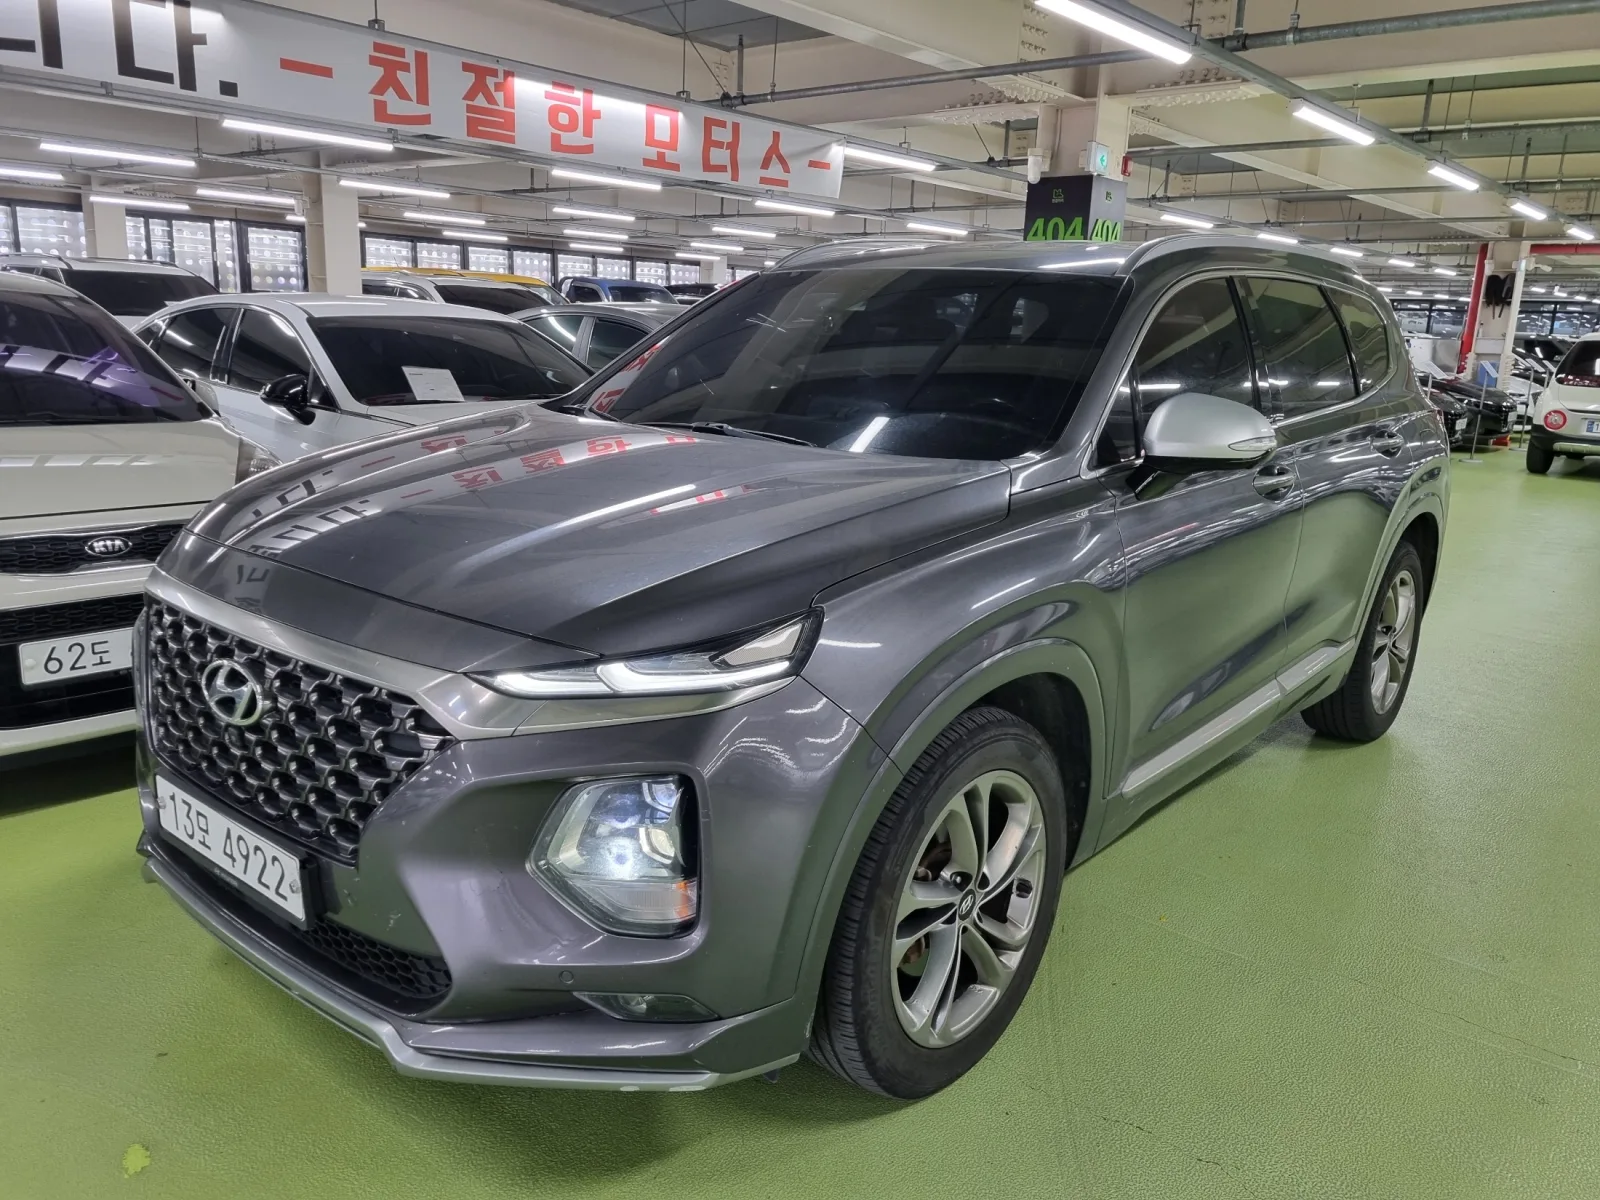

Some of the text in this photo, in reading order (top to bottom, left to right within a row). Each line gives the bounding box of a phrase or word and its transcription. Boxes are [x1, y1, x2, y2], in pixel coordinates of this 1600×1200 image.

[369, 41, 601, 154] 친절한
[642, 103, 790, 188] 모터스
[1027, 217, 1084, 240] 404
[1091, 218, 1121, 241] 404
[93, 539, 125, 553] KIA
[43, 640, 111, 674] 62도
[169, 792, 288, 901] 13모 4922
